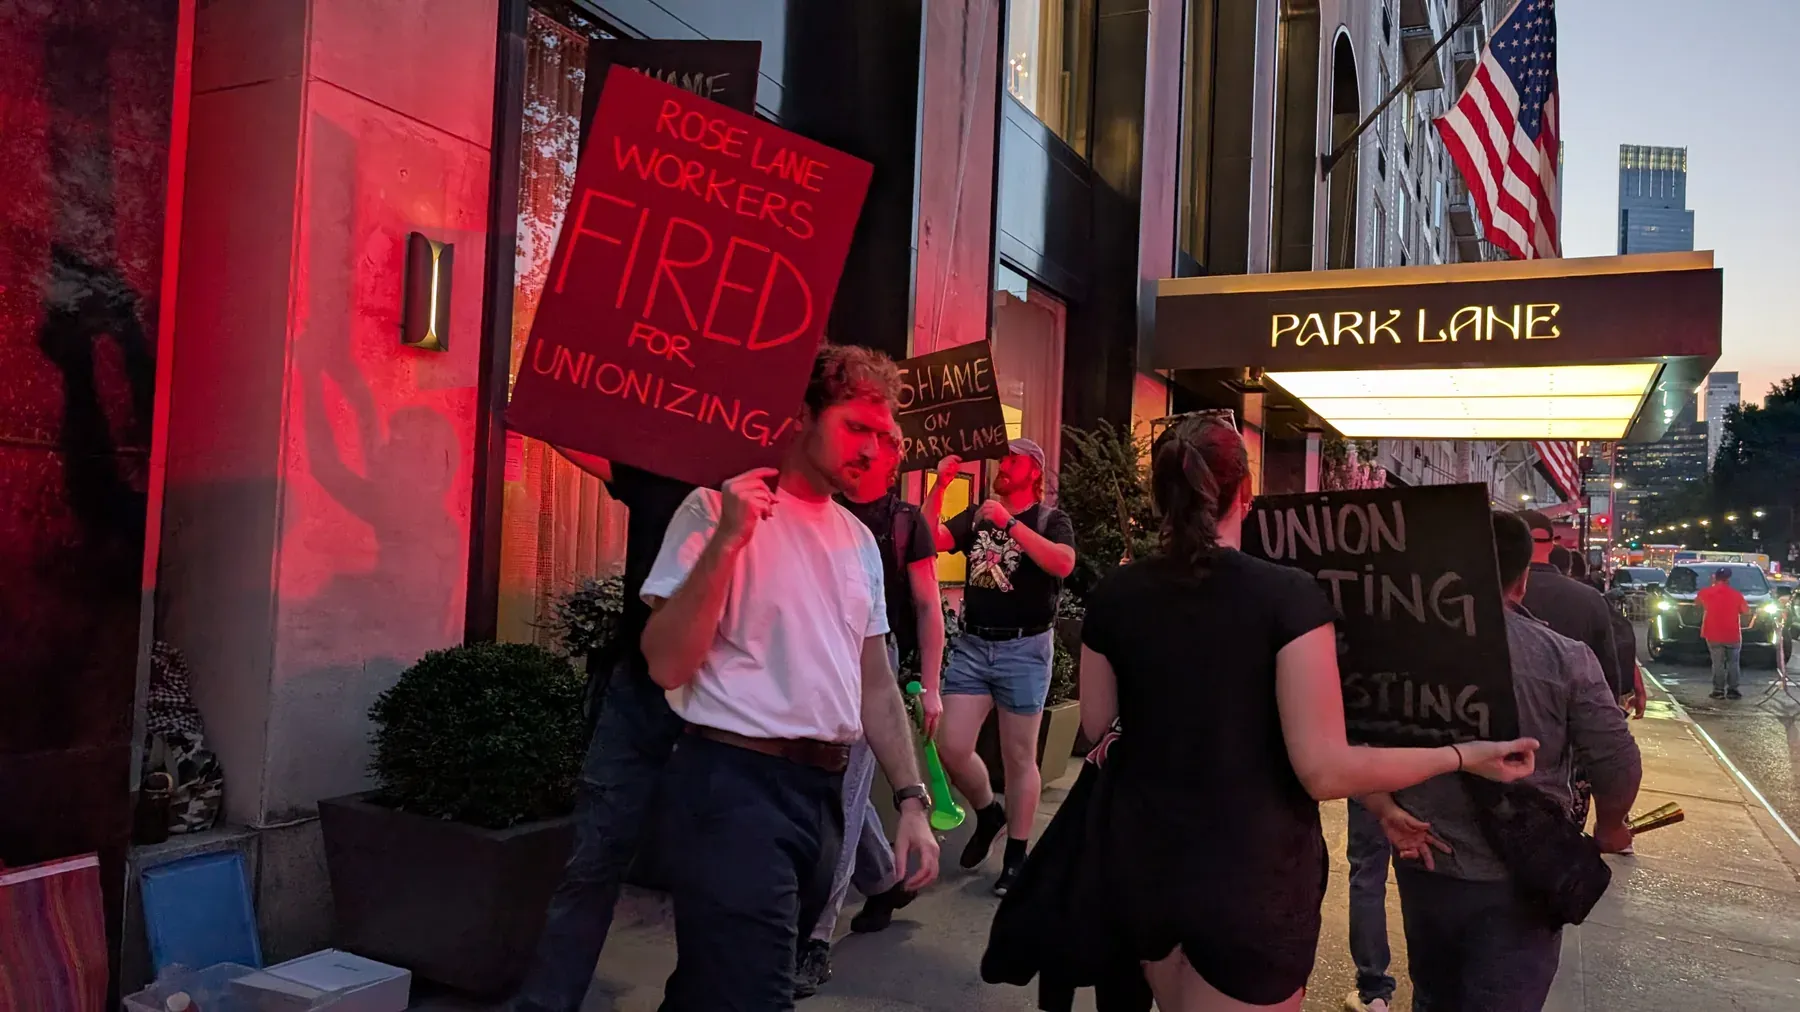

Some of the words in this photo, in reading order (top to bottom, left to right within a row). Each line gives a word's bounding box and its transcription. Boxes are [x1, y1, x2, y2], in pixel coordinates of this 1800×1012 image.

[656, 99, 749, 158] ROSE
[751, 137, 830, 192] LANE
[614, 136, 814, 240] WORKERS
[555, 188, 813, 351] FIRED
[628, 322, 695, 368] FOR
[1270, 309, 1402, 348] PARK
[1418, 303, 1561, 343] LANE
[532, 338, 793, 447] UNIONIZING!
[897, 358, 990, 409] SHAME
[900, 435, 954, 463] PARK
[959, 424, 1004, 452] LANE
[924, 411, 951, 431] ON
[1343, 671, 1490, 738] STING
